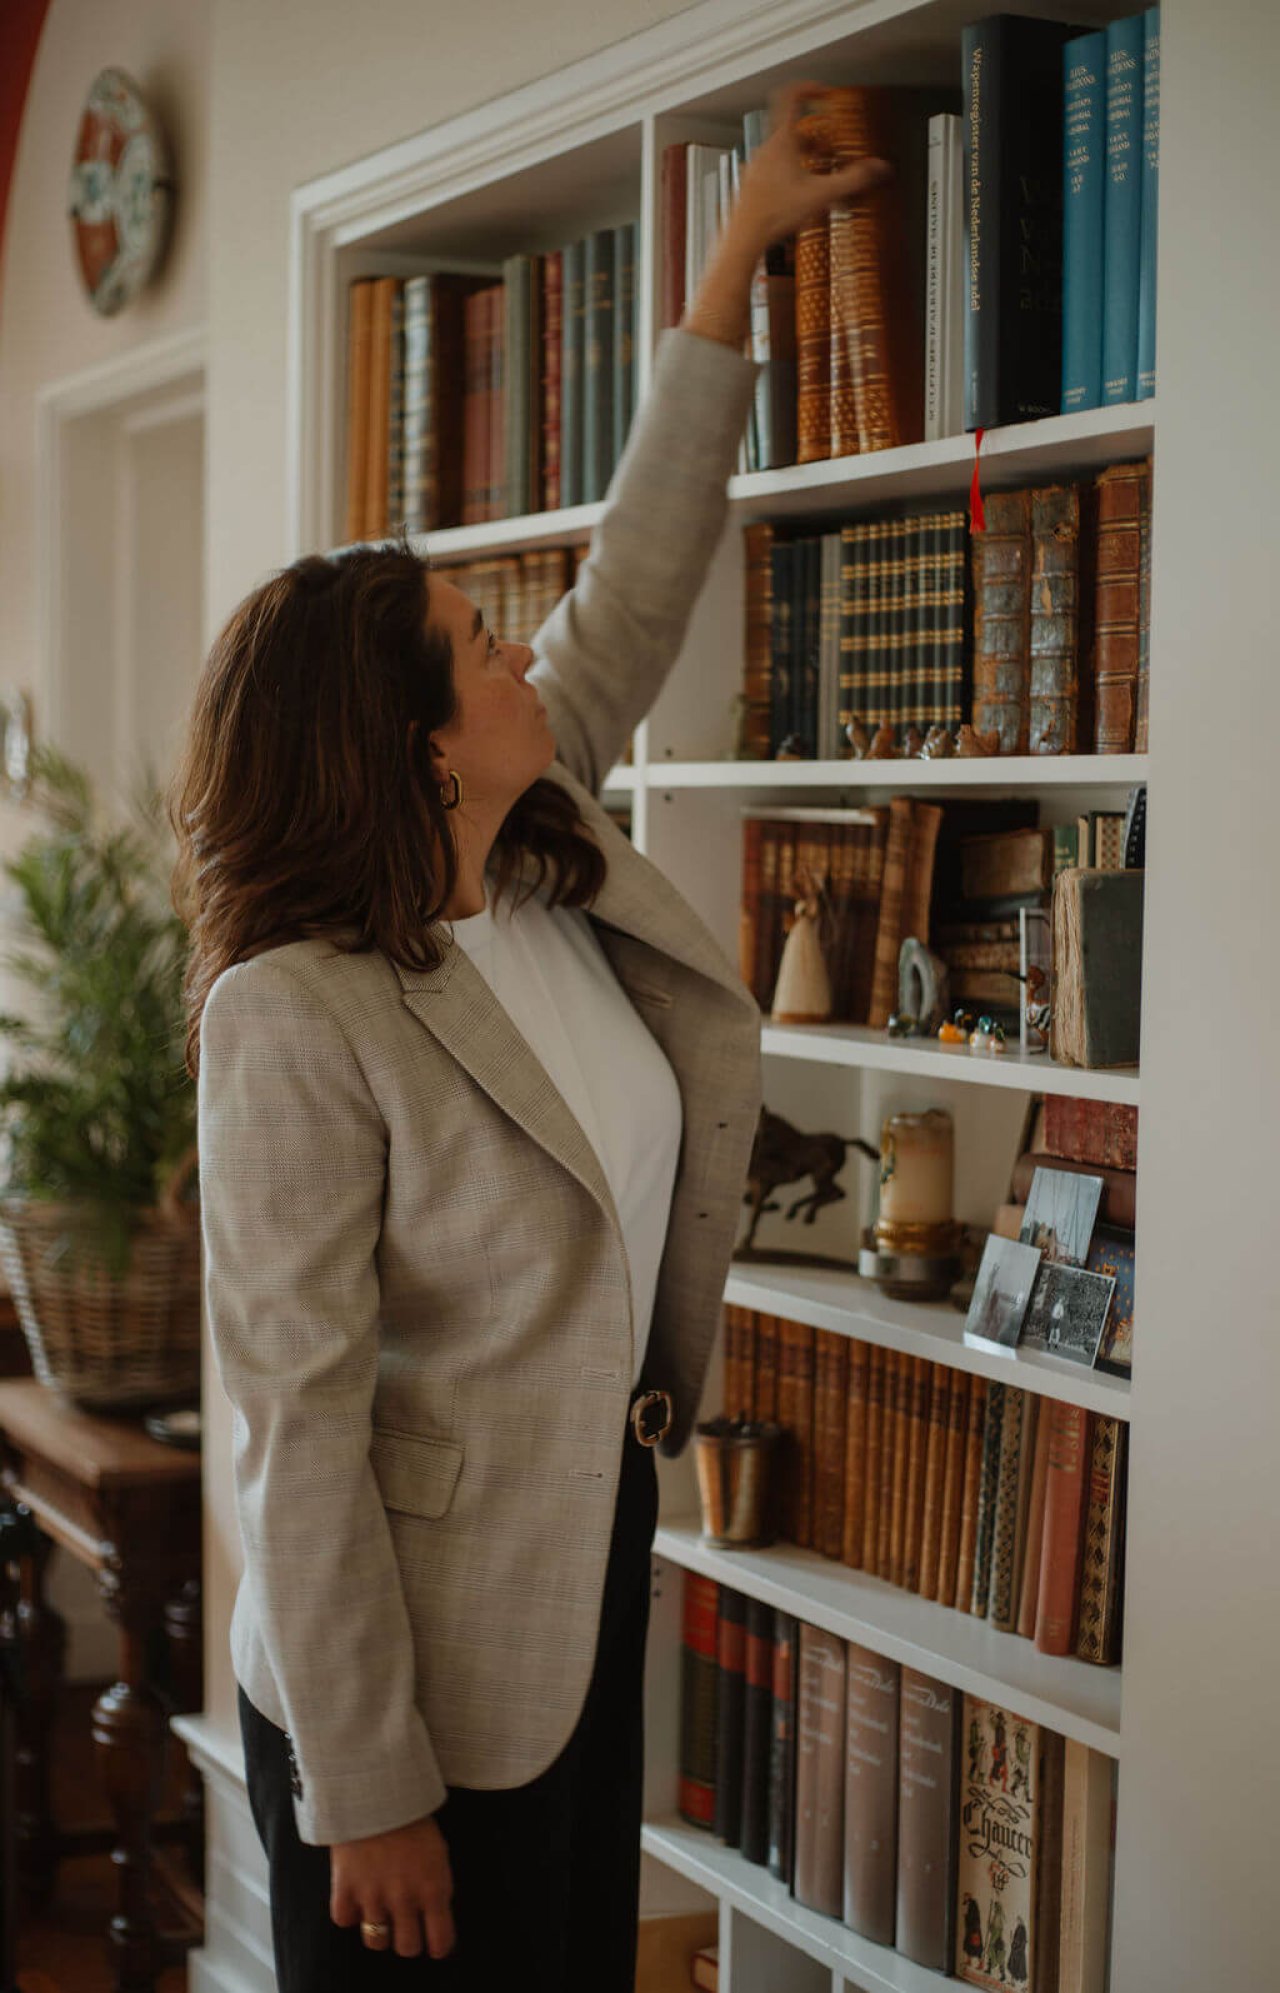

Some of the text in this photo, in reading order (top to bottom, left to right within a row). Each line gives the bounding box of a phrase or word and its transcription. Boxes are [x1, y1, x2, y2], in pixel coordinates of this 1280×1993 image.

[970, 48, 983, 311] Wapenregister van de Nederlandse adel
[963, 1799, 1032, 1860] Chaucer
